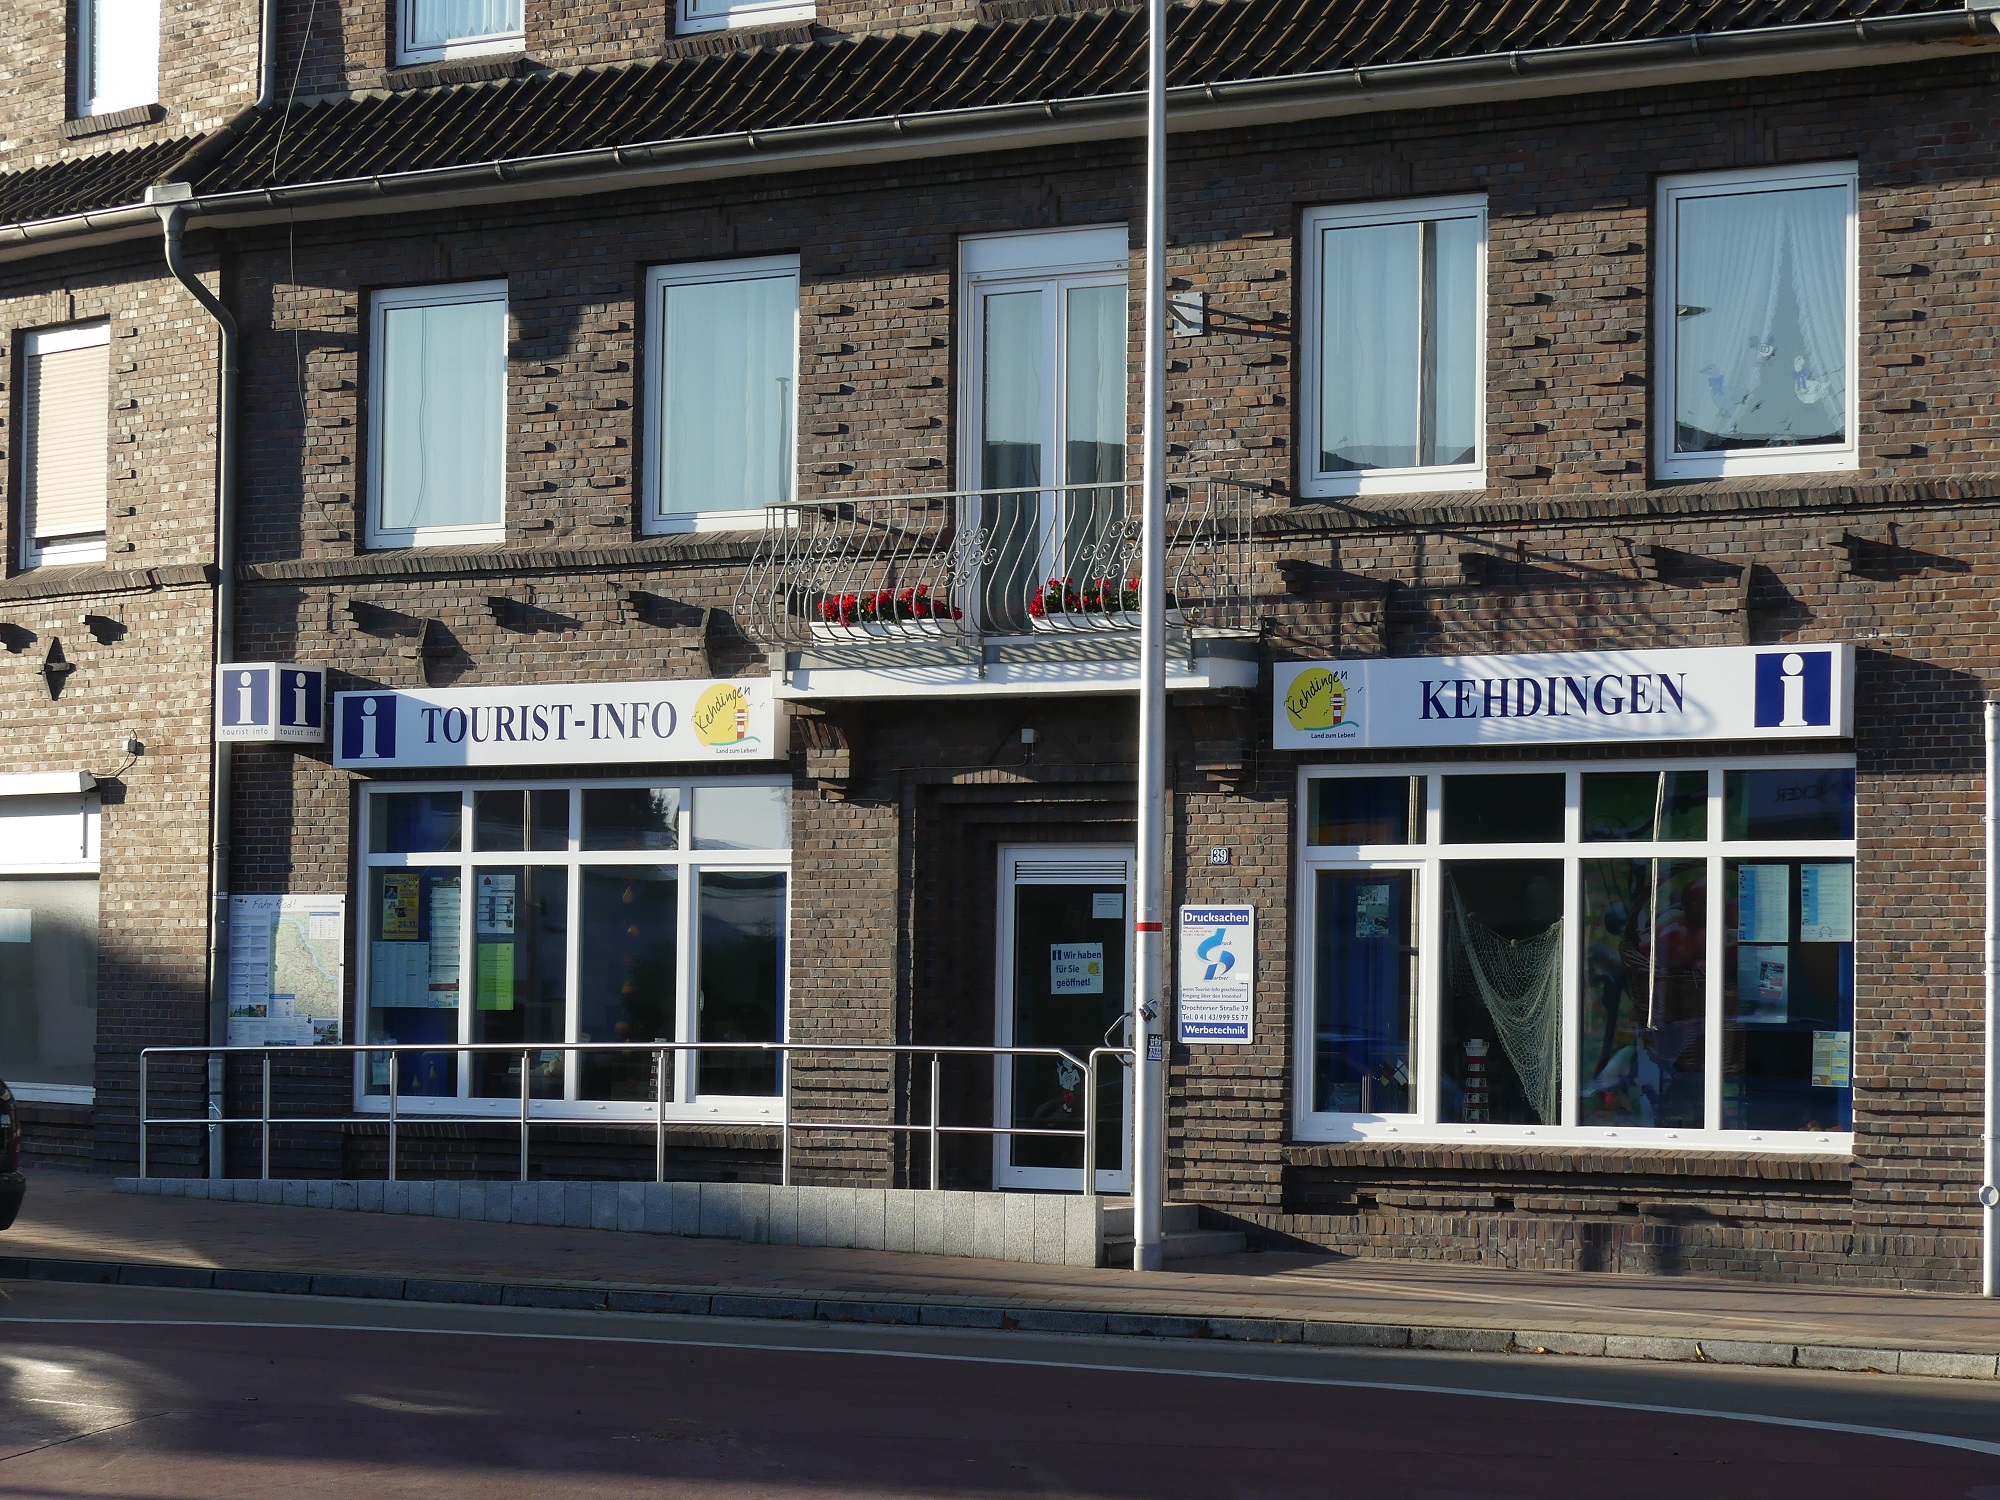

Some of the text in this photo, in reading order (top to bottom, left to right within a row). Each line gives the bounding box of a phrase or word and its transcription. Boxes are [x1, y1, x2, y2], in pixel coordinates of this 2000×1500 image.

[1288, 670, 1348, 719] Kehdingen
[1418, 673, 1687, 720] KEHDINGEN
[695, 686, 751, 735] Kehdingen
[421, 701, 677, 744] TOURIST-INFO
[222, 728, 248, 736] tourist
[280, 728, 321, 737] tourist info
[1213, 849, 1227, 862] 39
[252, 897, 272, 909] Fahr
[275, 898, 297, 909] Rad!
[1184, 912, 1249, 922] Drucksachen
[1063, 950, 1102, 959] Wir haben
[1056, 964, 1080, 973] für Sie
[1056, 977, 1091, 989] geöffnet!
[1184, 1025, 1246, 1035] Werbetechnik
